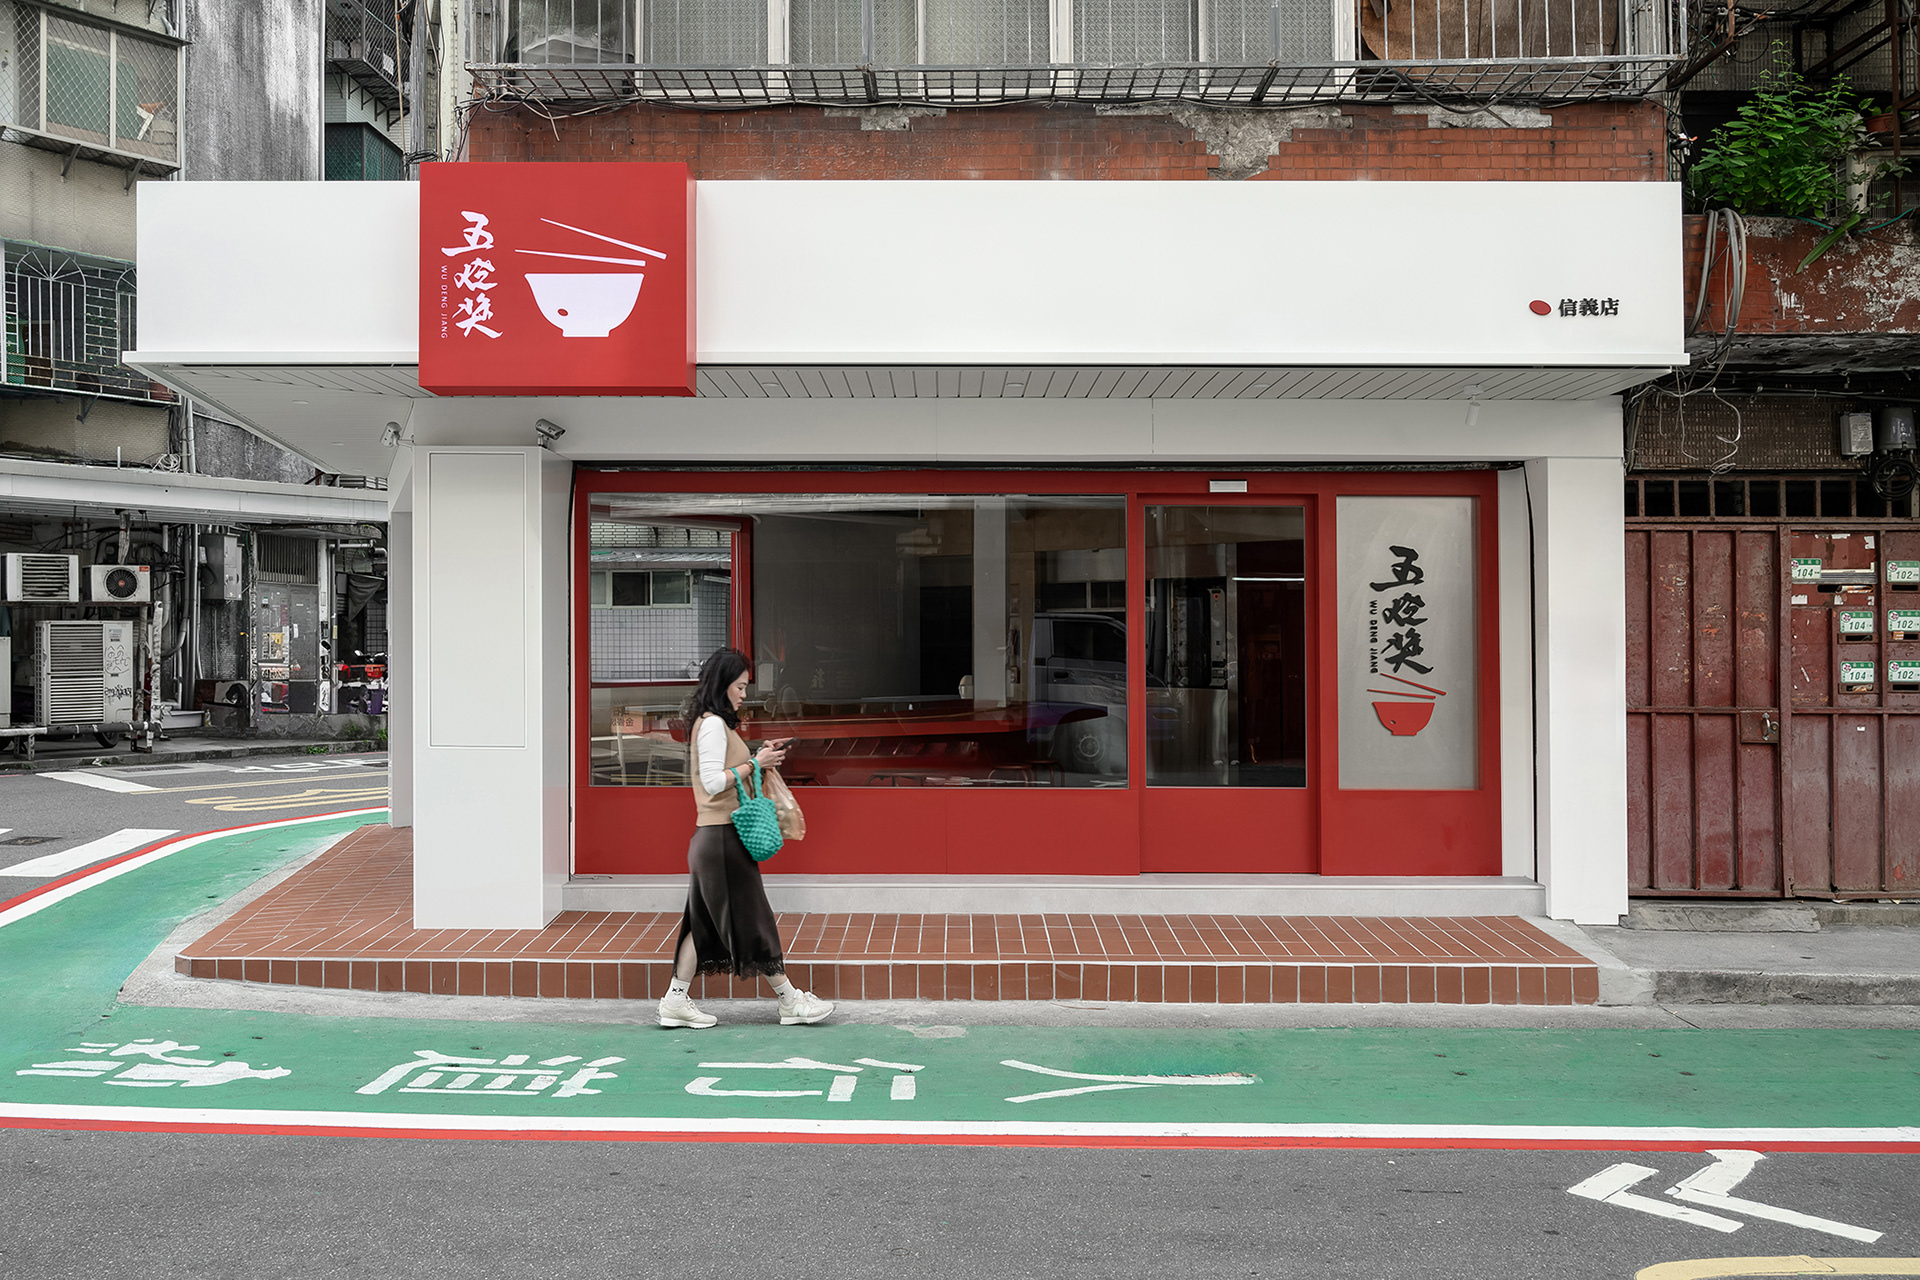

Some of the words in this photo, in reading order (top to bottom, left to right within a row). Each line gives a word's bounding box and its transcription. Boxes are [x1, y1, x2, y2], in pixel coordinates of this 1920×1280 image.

[441, 265, 448, 281] WU
[1558, 297, 1619, 317] 信義店
[1797, 568, 1814, 577] 104
[1896, 570, 1913, 580] 102
[1369, 600, 1378, 615] WU
[1849, 621, 1866, 630] 104
[1896, 620, 1914, 629] 102
[1369, 619, 1378, 644] DENG
[1370, 648, 1379, 674] JIANG
[1850, 671, 1867, 680] 104
[1897, 670, 1914, 680] 102
[356, 1052, 1255, 1103] 人行道
